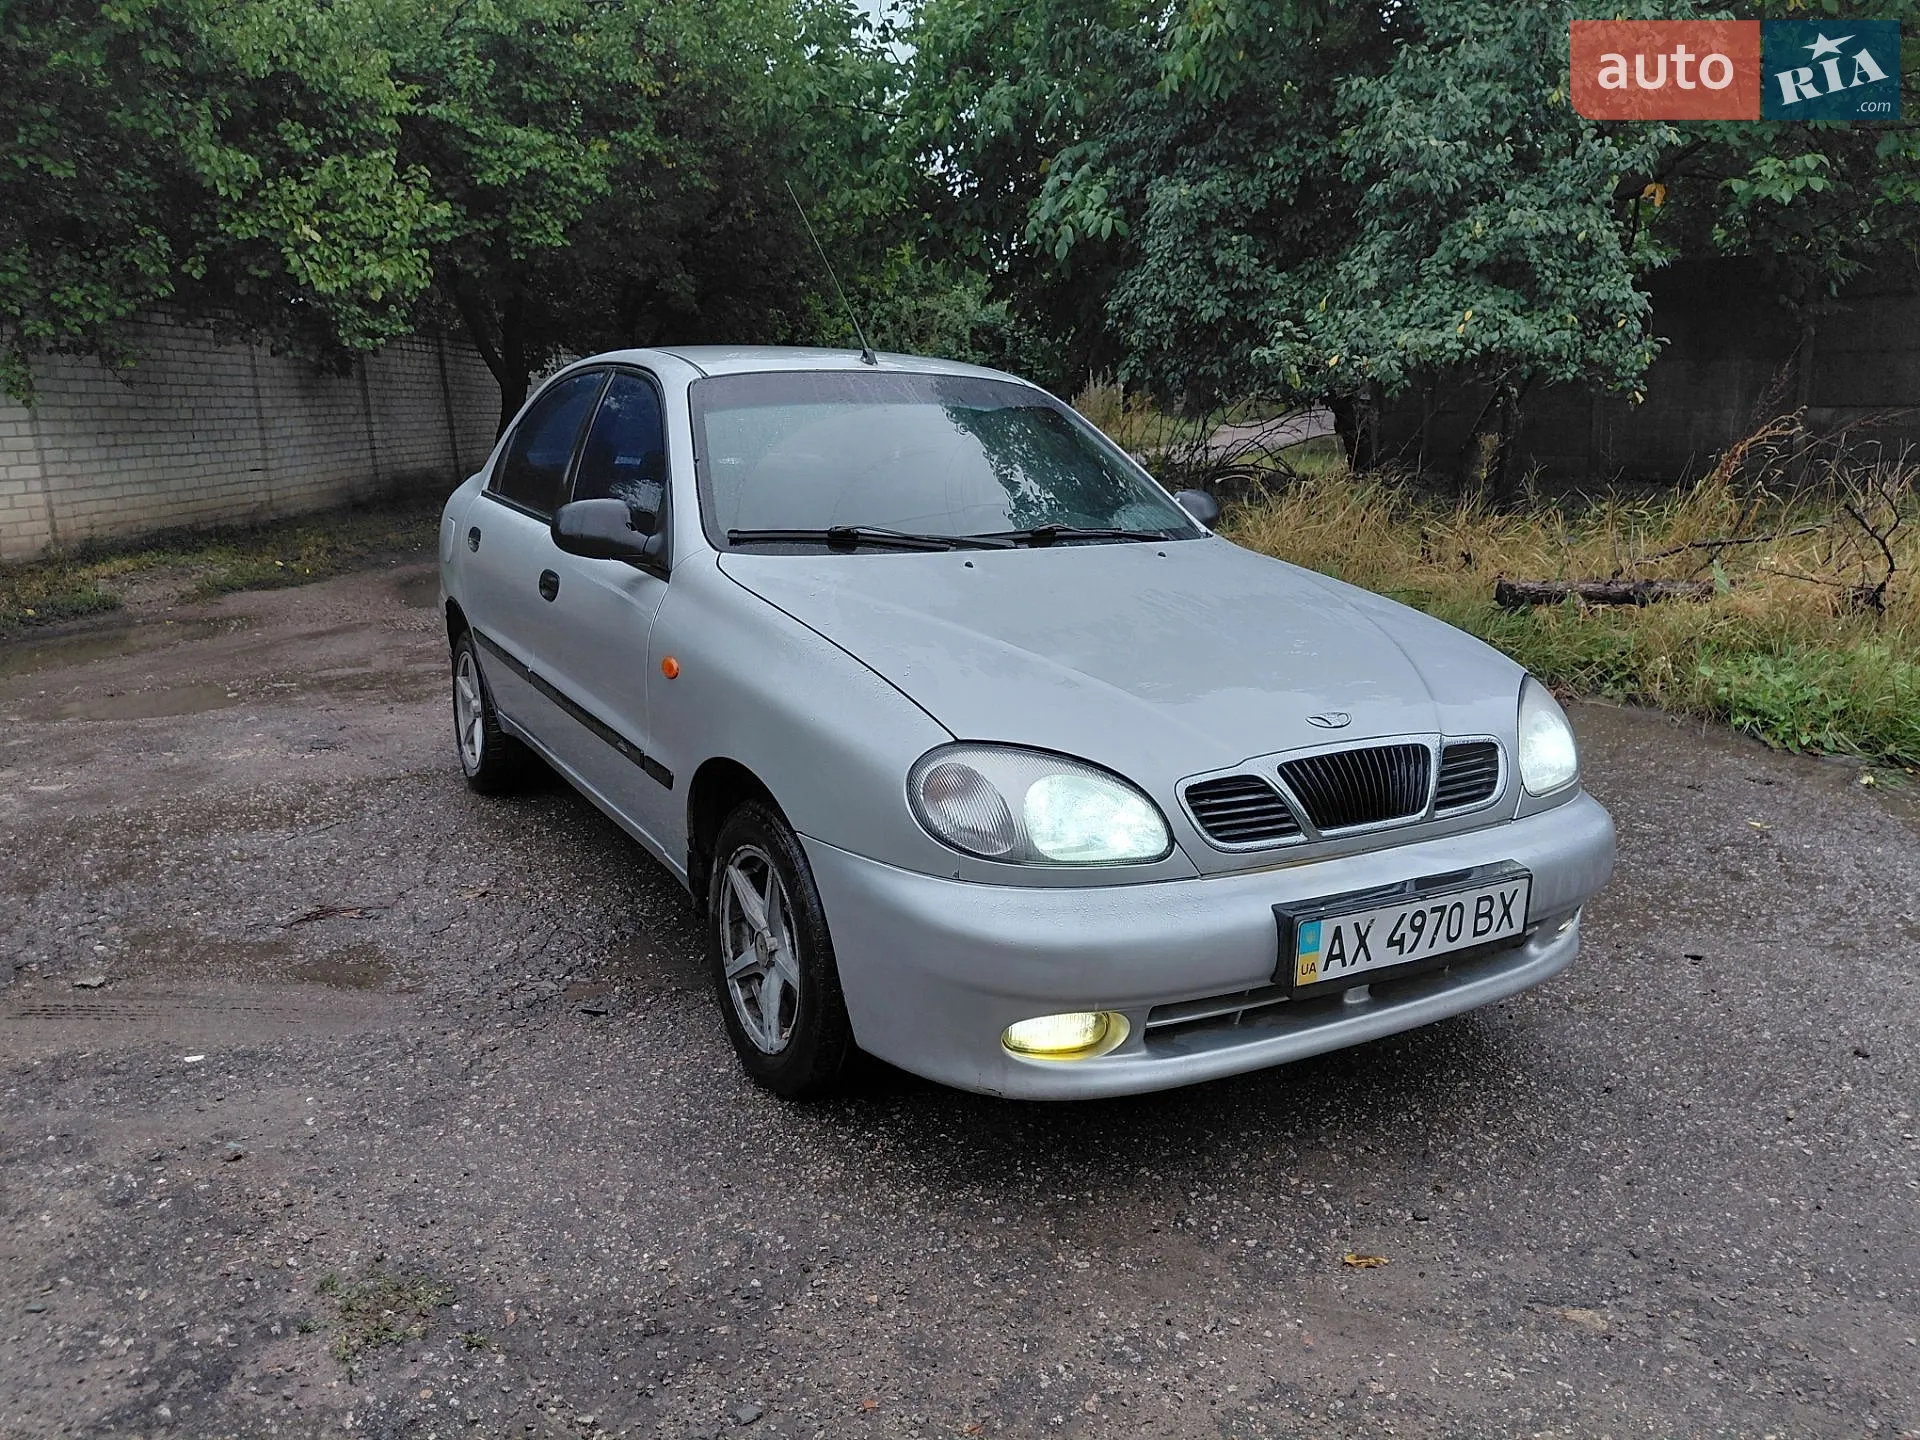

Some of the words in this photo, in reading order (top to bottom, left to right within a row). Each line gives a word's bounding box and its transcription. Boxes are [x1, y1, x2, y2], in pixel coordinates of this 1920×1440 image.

[1323, 917, 1376, 972] AX
[1386, 902, 1465, 955] 4970
[1472, 888, 1519, 937] BX
[1300, 962, 1317, 976] UA
